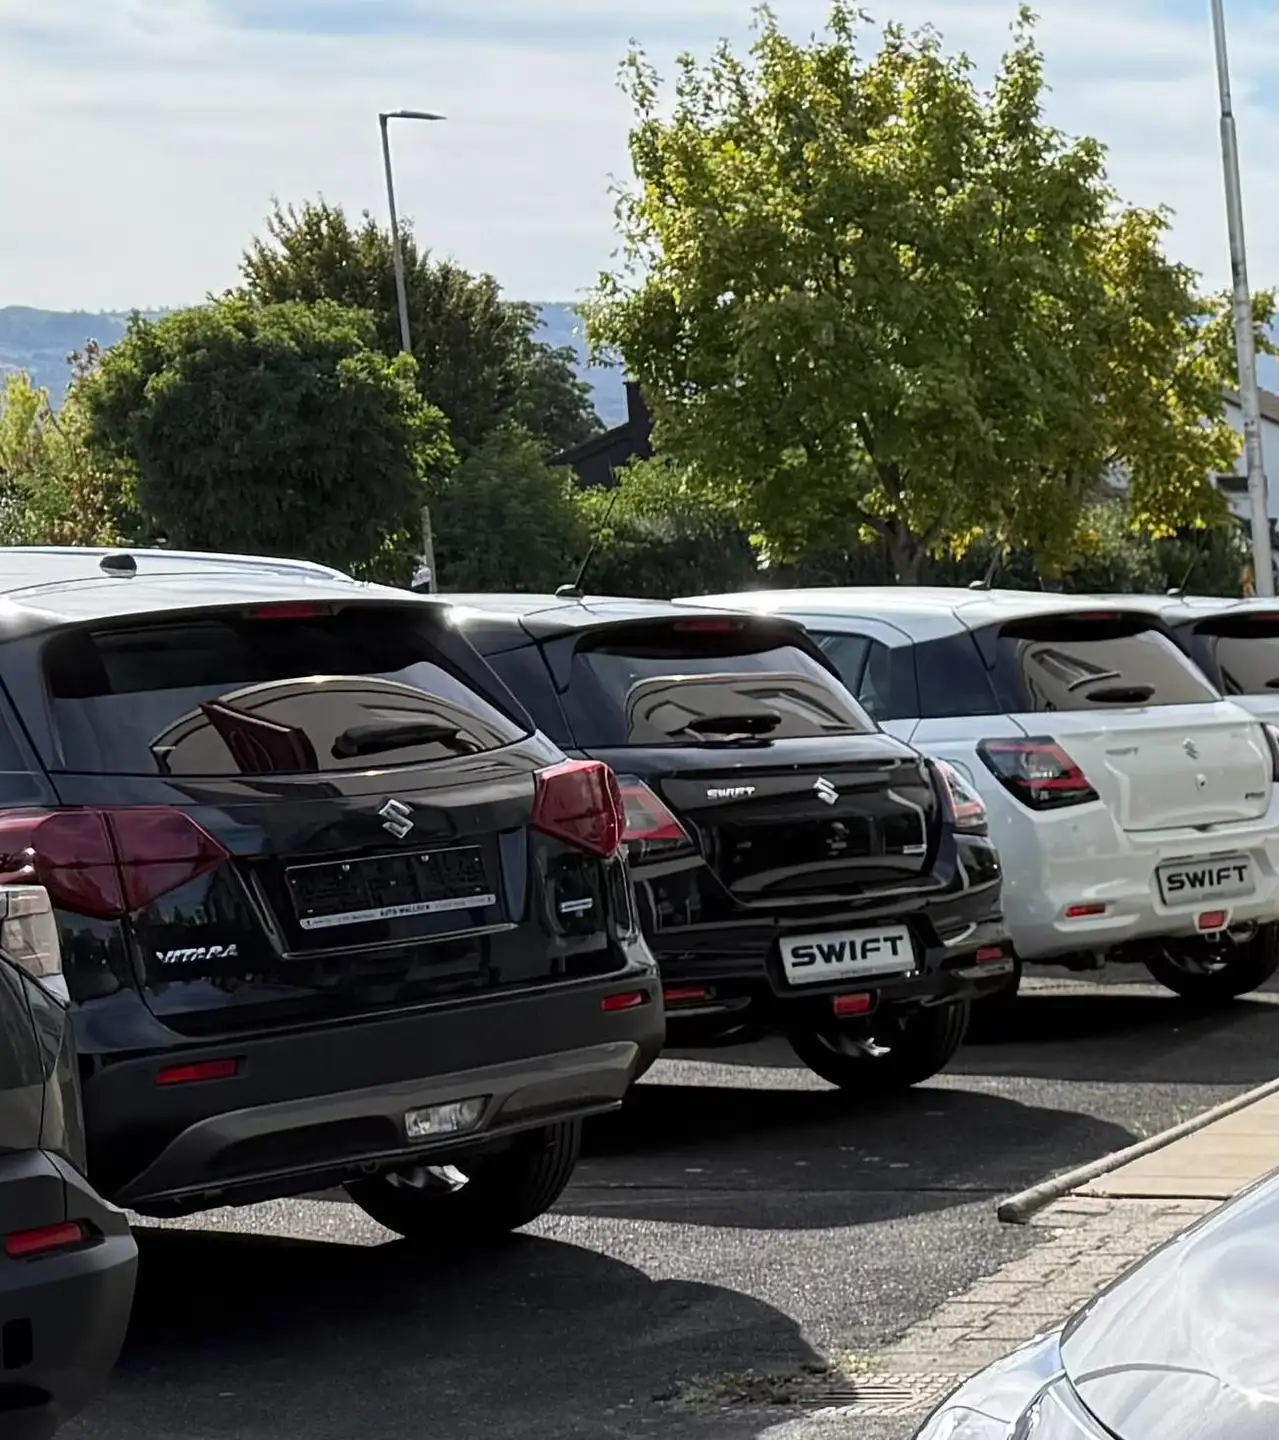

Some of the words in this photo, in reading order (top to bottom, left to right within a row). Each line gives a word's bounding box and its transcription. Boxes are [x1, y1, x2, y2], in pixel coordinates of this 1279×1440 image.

[1166, 864, 1248, 892] SWIFT
[155, 944, 238, 963] VITARA
[791, 935, 904, 968] SWIFT
